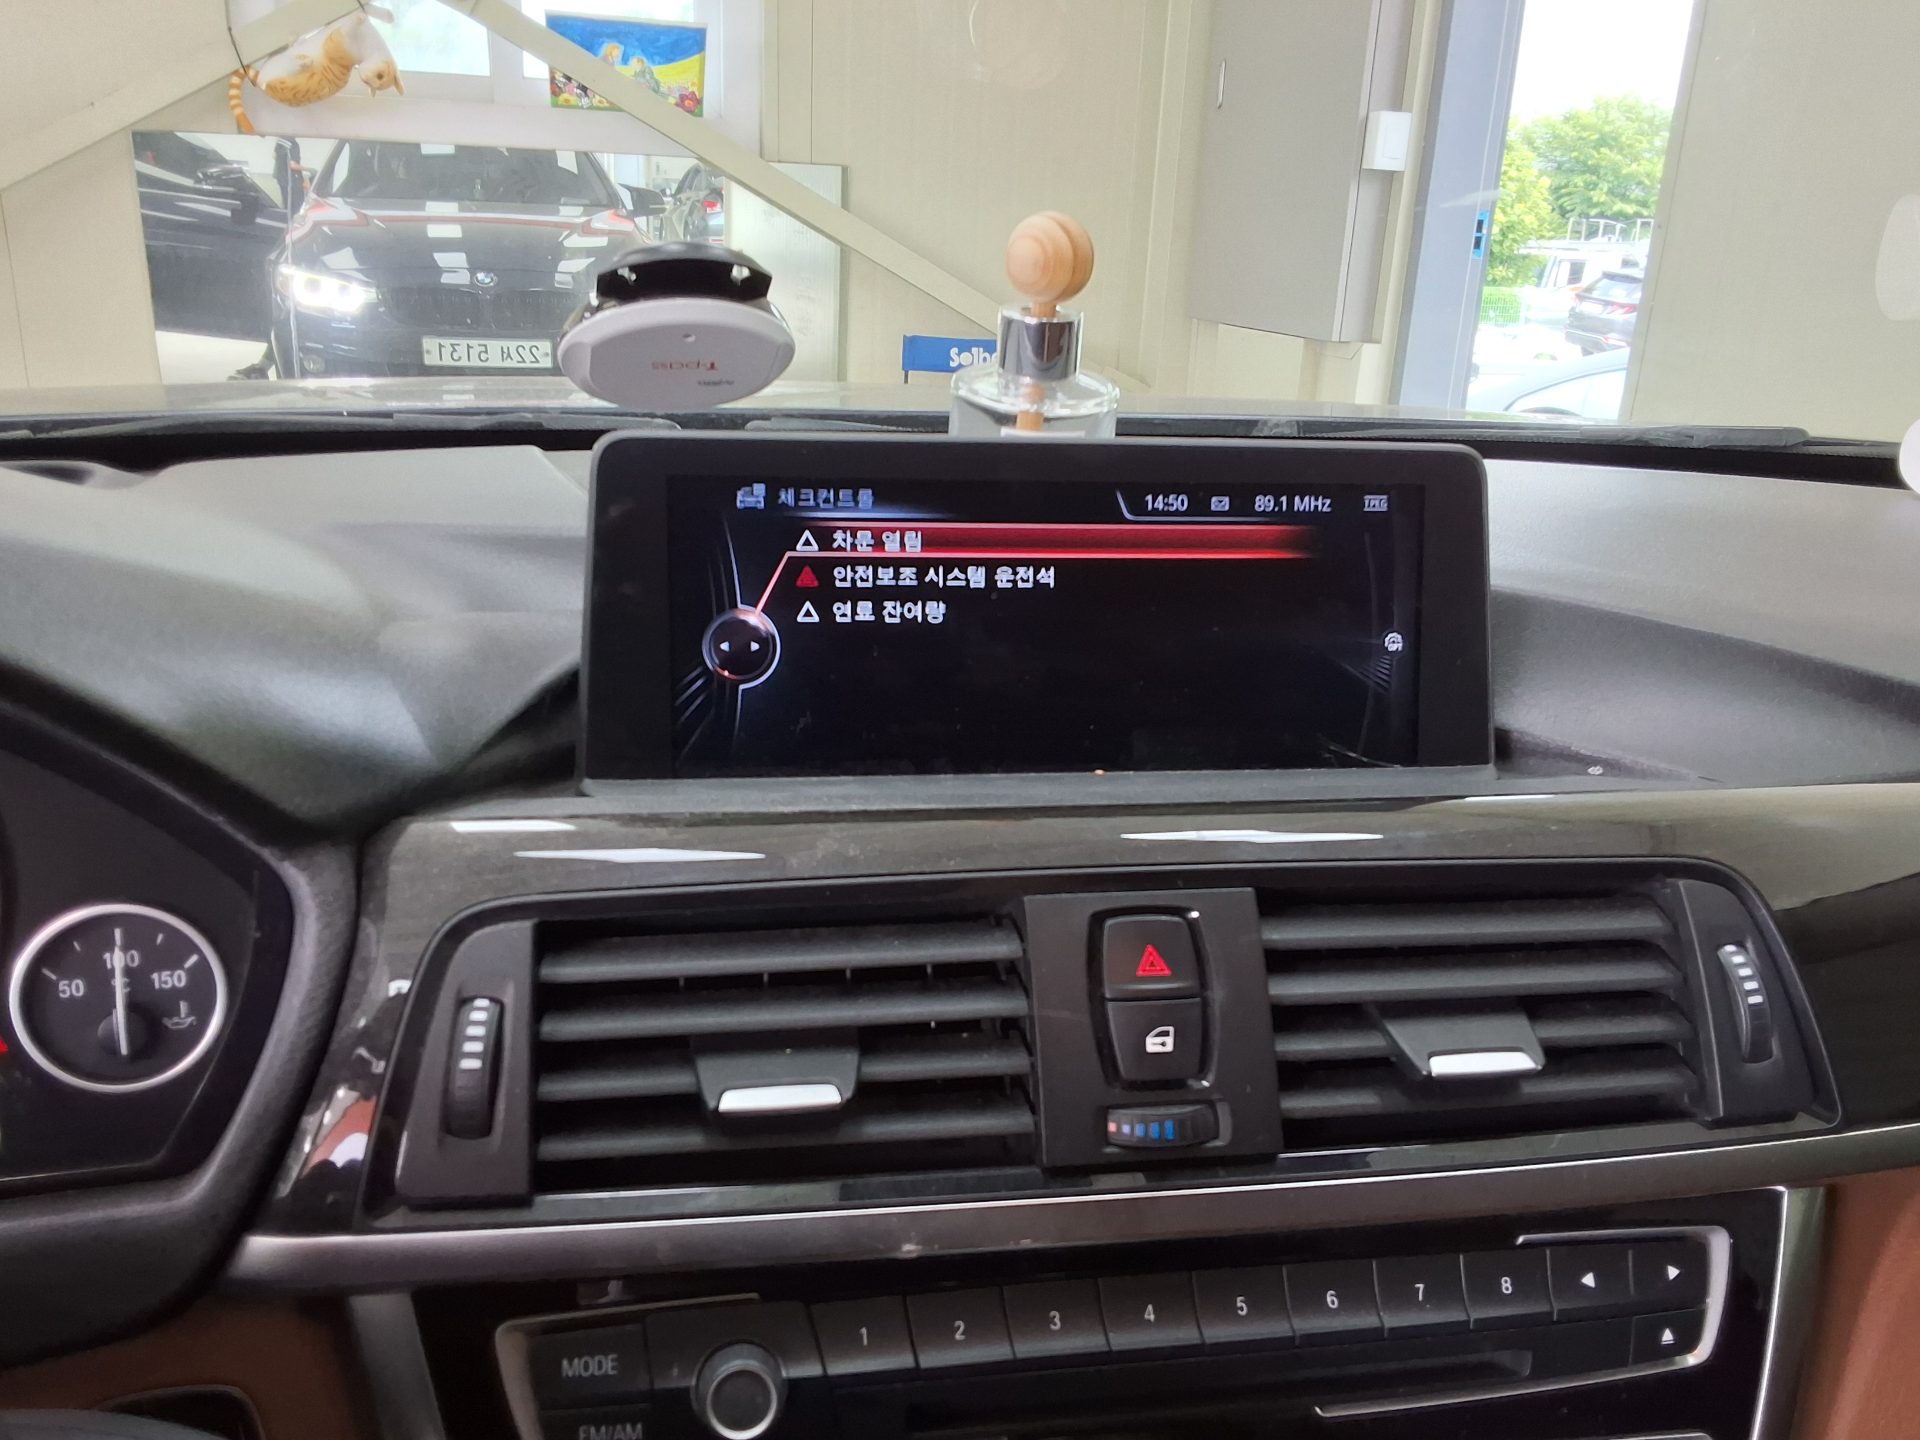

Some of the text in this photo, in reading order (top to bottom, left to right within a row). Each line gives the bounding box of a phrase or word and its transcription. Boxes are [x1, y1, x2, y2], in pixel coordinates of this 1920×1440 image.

[949, 346, 998, 367] Solb
[1144, 494, 1188, 512] 14:50
[1254, 494, 1332, 512] 89.1 MHz
[832, 529, 922, 553] 차문 열림
[833, 564, 1055, 589] 안전보조 시스템 운전석
[832, 600, 946, 624] 연료 잔여량
[58, 979, 84, 998] 50
[151, 970, 187, 989] 150
[859, 1276, 1513, 1346] 1 2 3 4 5 6 7 8
[562, 1353, 619, 1377] MODE
